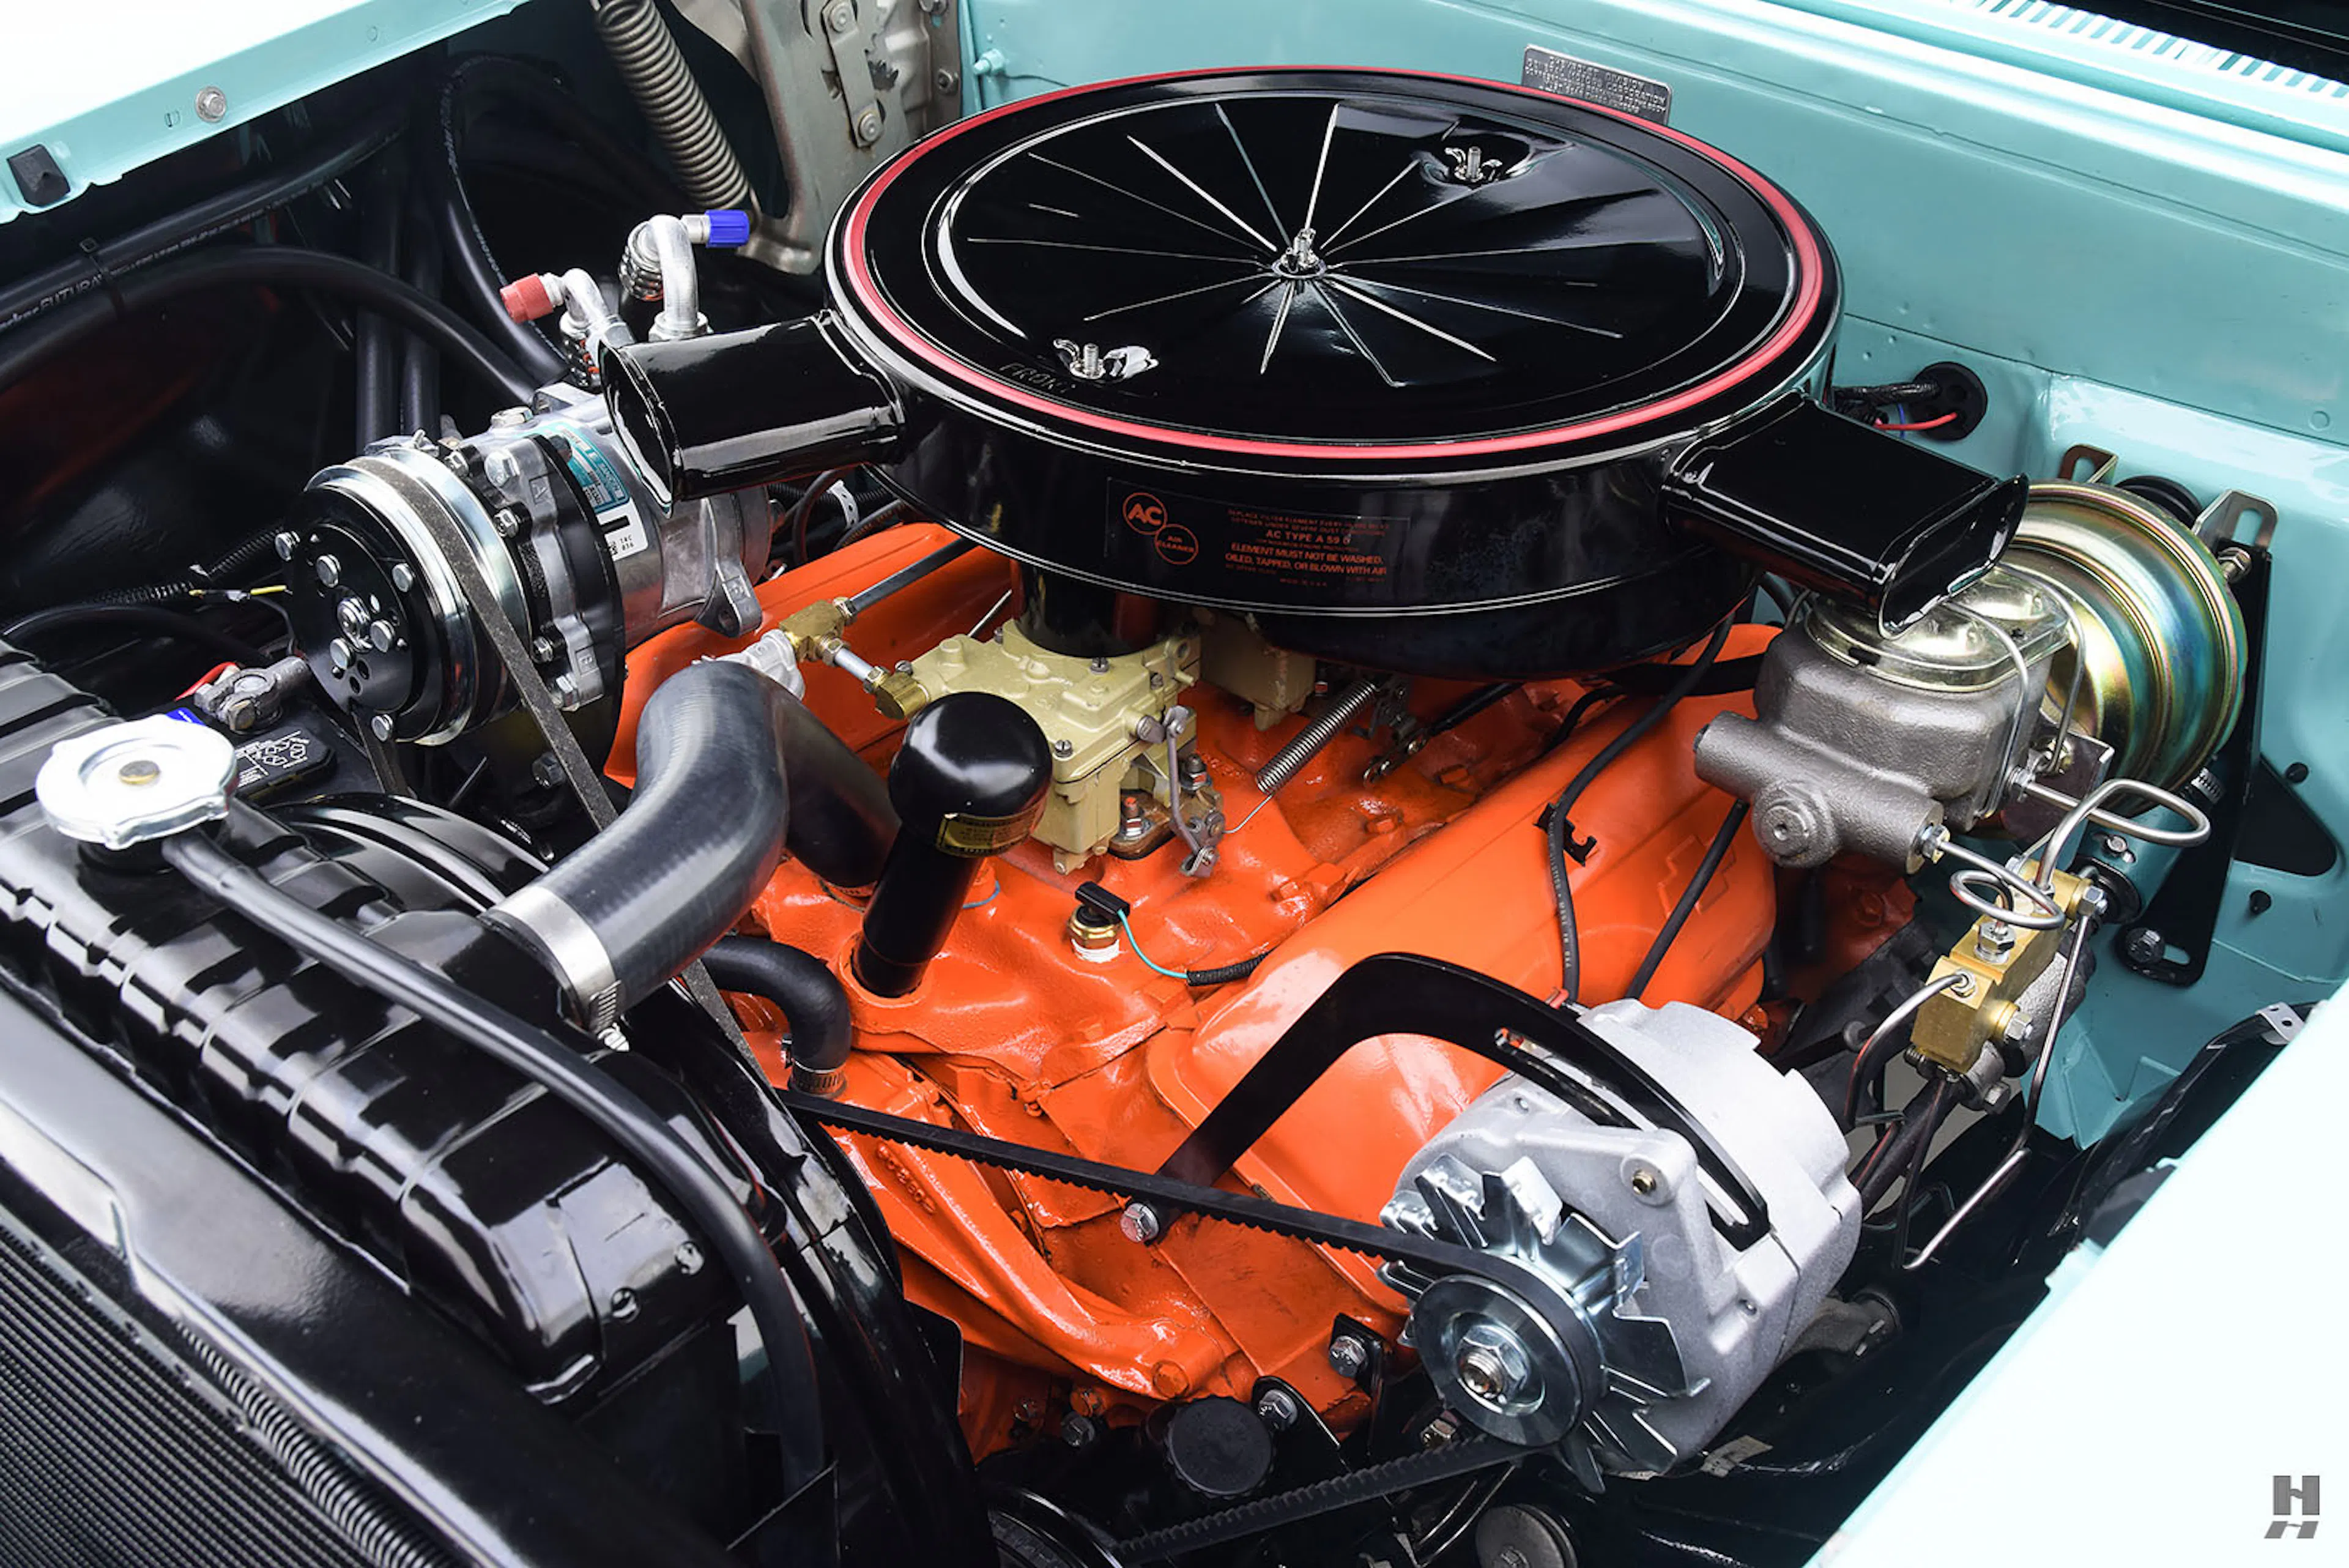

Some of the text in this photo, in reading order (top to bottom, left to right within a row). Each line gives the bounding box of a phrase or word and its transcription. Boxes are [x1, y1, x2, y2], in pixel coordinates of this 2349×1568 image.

[1127, 502, 1162, 526] AC
[1266, 529, 1282, 539] AC
[1285, 530, 1312, 542] TYPE
[1315, 535, 1324, 543] A
[1230, 542, 1274, 555] ELEMENT
[1275, 548, 1304, 559] MUST
[1305, 551, 1326, 561] NOT
[1326, 552, 1338, 562] BE
[1294, 562, 1308, 571] OR
[1310, 563, 1345, 573] BLOWN
[1346, 565, 1371, 574] WITH
[1371, 567, 1387, 576] AIR
